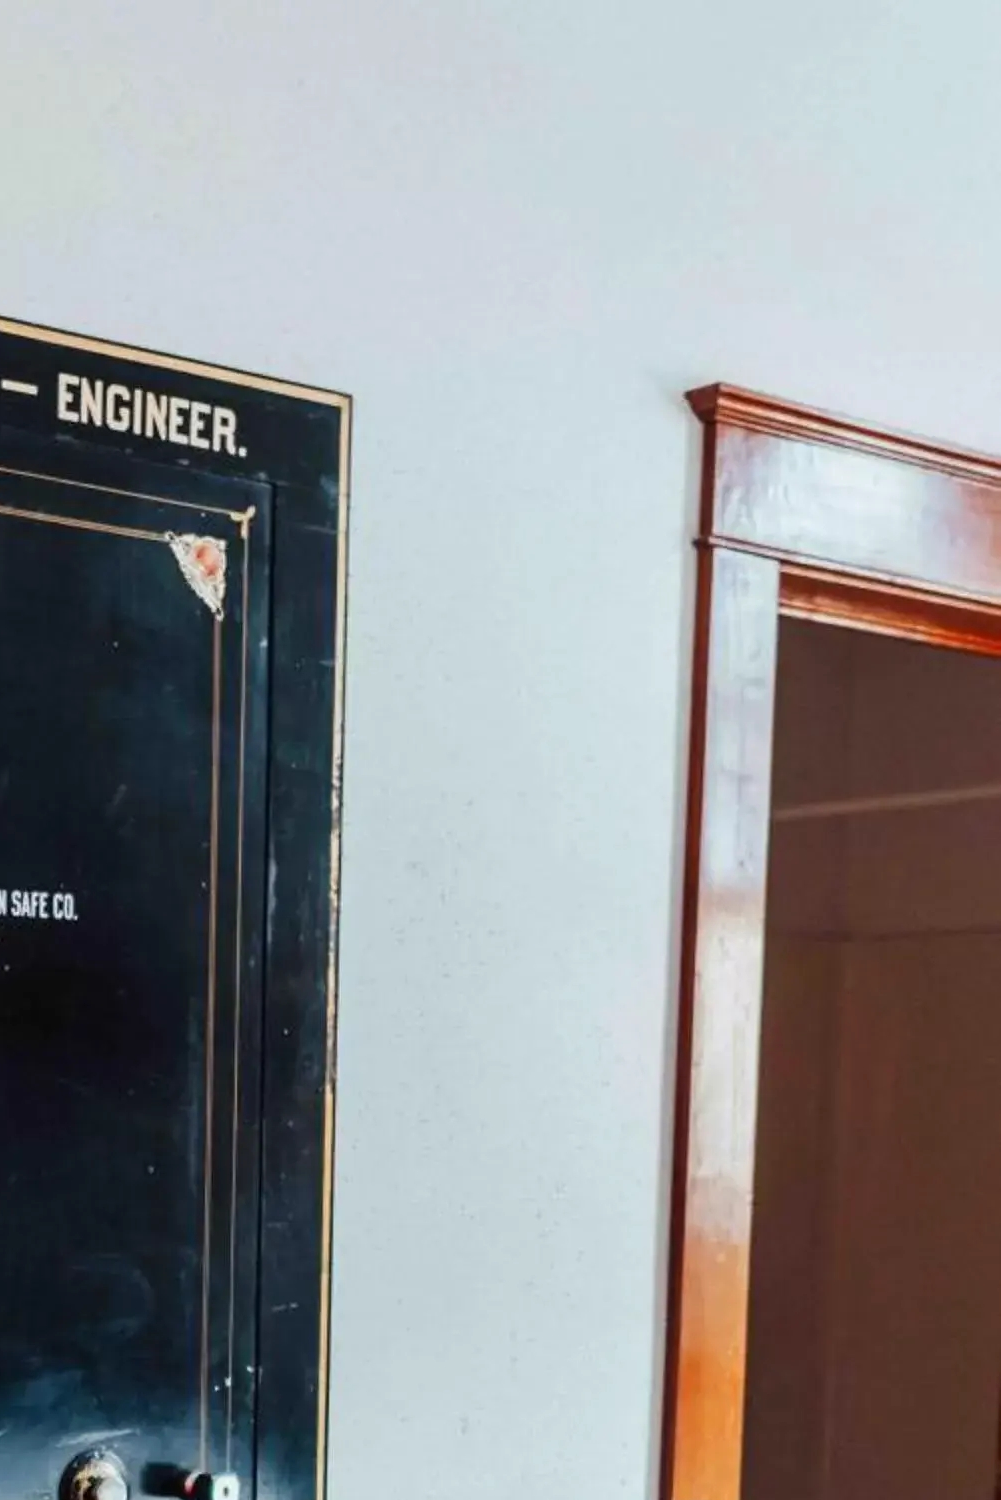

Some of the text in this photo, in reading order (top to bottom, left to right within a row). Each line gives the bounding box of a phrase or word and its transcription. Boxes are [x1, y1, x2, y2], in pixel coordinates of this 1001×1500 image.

[56, 373, 248, 457] ENGINEER.
[10, 890, 49, 919] SAFE
[52, 893, 79, 920] CO.
